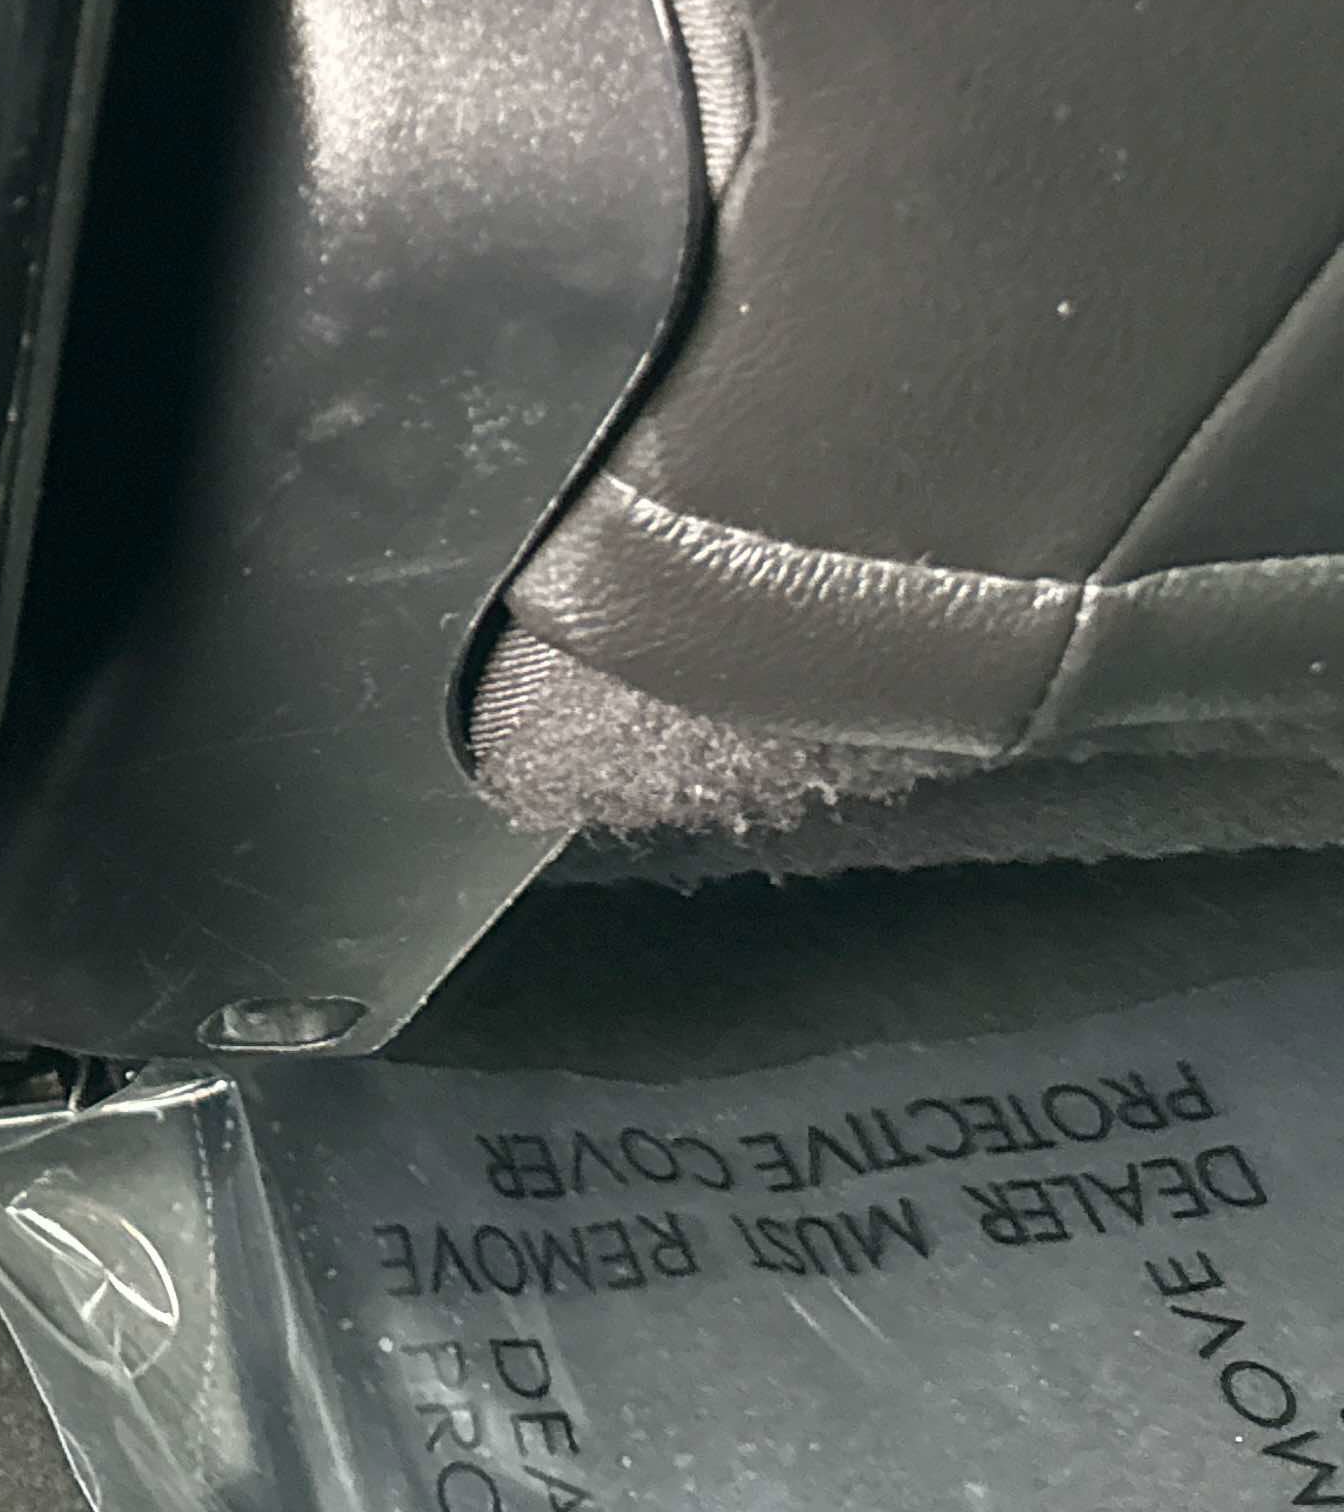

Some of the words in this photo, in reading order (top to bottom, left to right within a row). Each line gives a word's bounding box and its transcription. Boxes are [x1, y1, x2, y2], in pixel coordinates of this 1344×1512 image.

[475, 1127, 733, 1199] COVER
[739, 1061, 1219, 1192] PROTECTIVE
[730, 1197, 928, 1276] MUST
[961, 1144, 1267, 1245] DEALER
[372, 1212, 700, 1296] REMOVE
